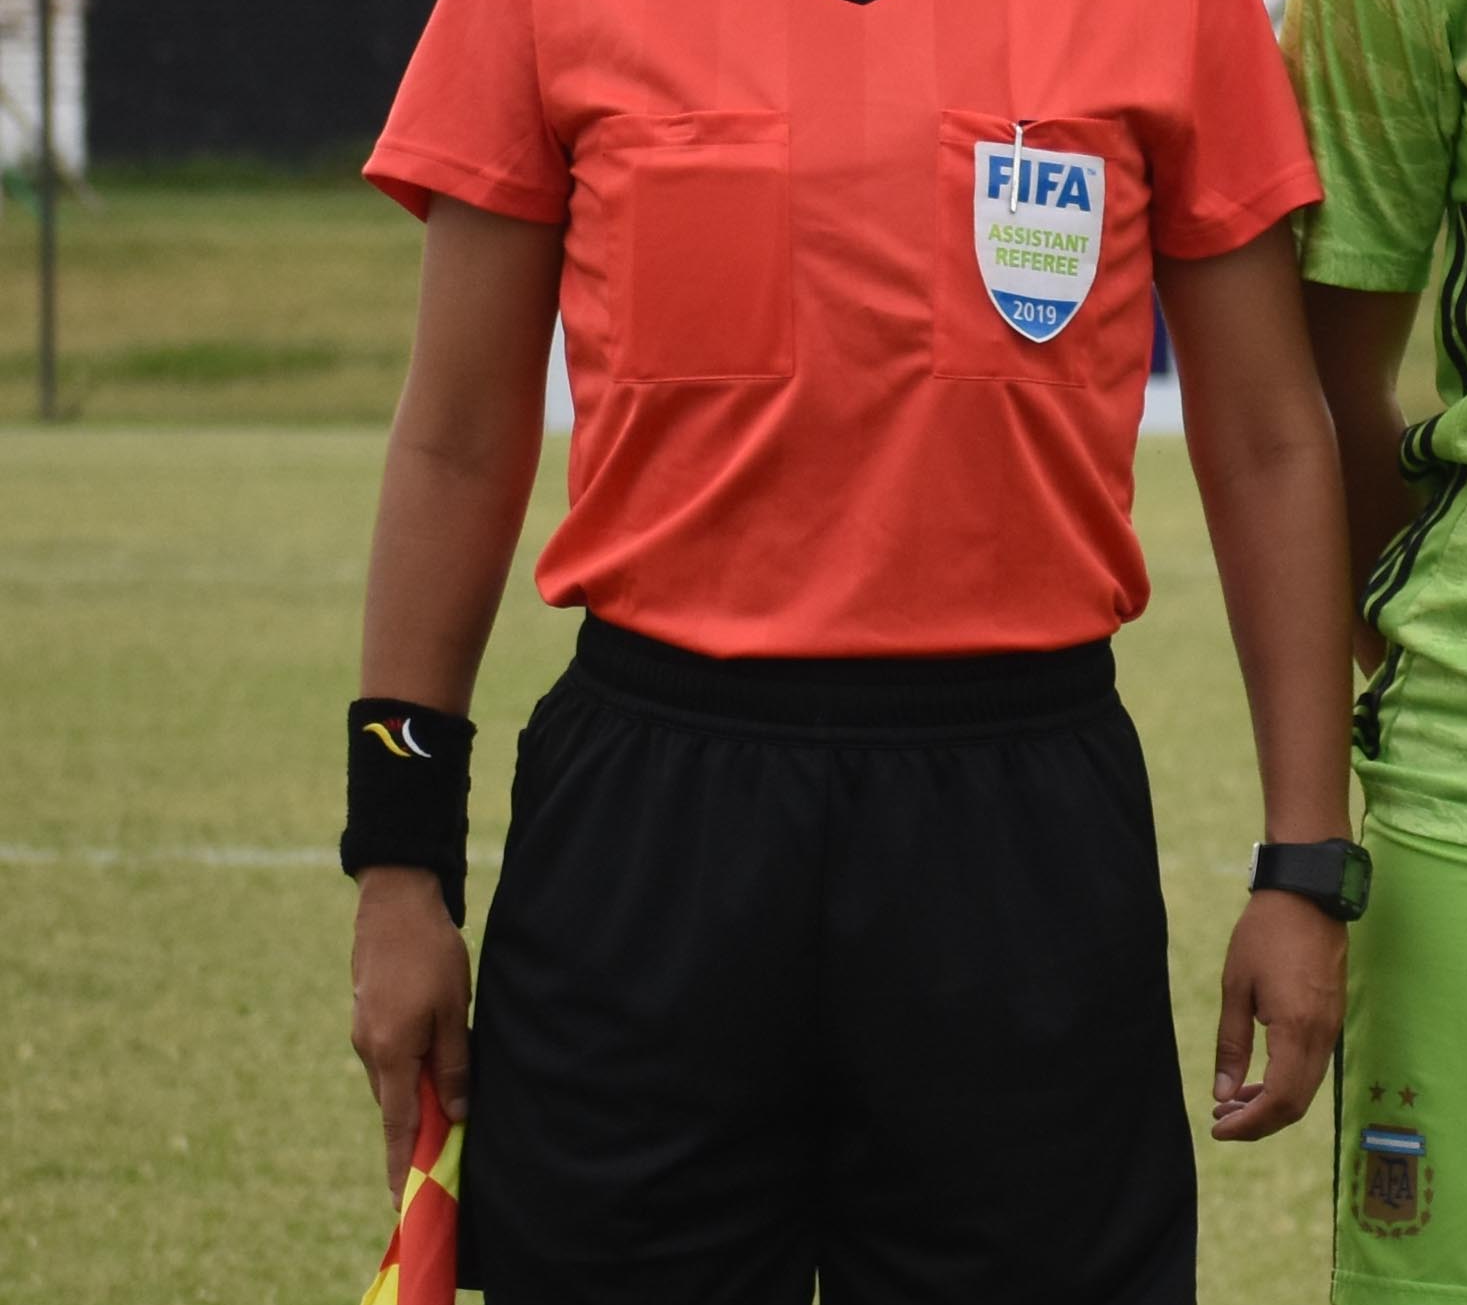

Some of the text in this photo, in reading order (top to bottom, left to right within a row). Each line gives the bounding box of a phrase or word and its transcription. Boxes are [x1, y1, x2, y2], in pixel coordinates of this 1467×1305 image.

[988, 155, 1091, 212] FIFA
[988, 223, 1089, 254] ASSISTANT
[995, 247, 1080, 277] REFEREE
[1012, 300, 1057, 325] 2019
